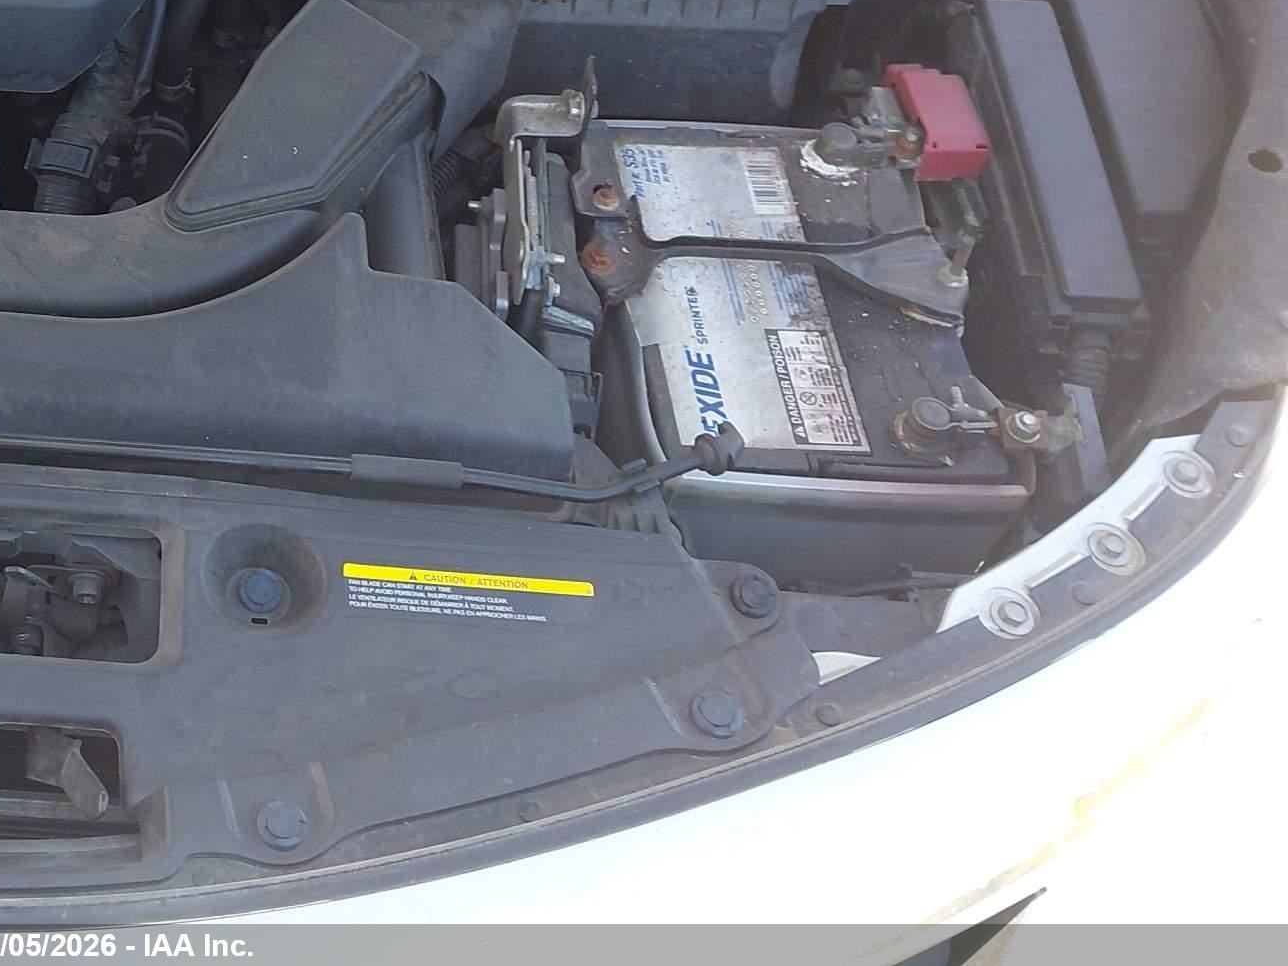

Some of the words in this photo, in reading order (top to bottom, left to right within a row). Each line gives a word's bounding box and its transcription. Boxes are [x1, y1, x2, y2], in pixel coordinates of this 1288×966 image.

[621, 148, 639, 169] S35
[686, 287, 709, 346] SPRINTER
[685, 349, 728, 437] EXIDE
[424, 574, 466, 584] CAUTION
[477, 578, 528, 589] ATTENTION
